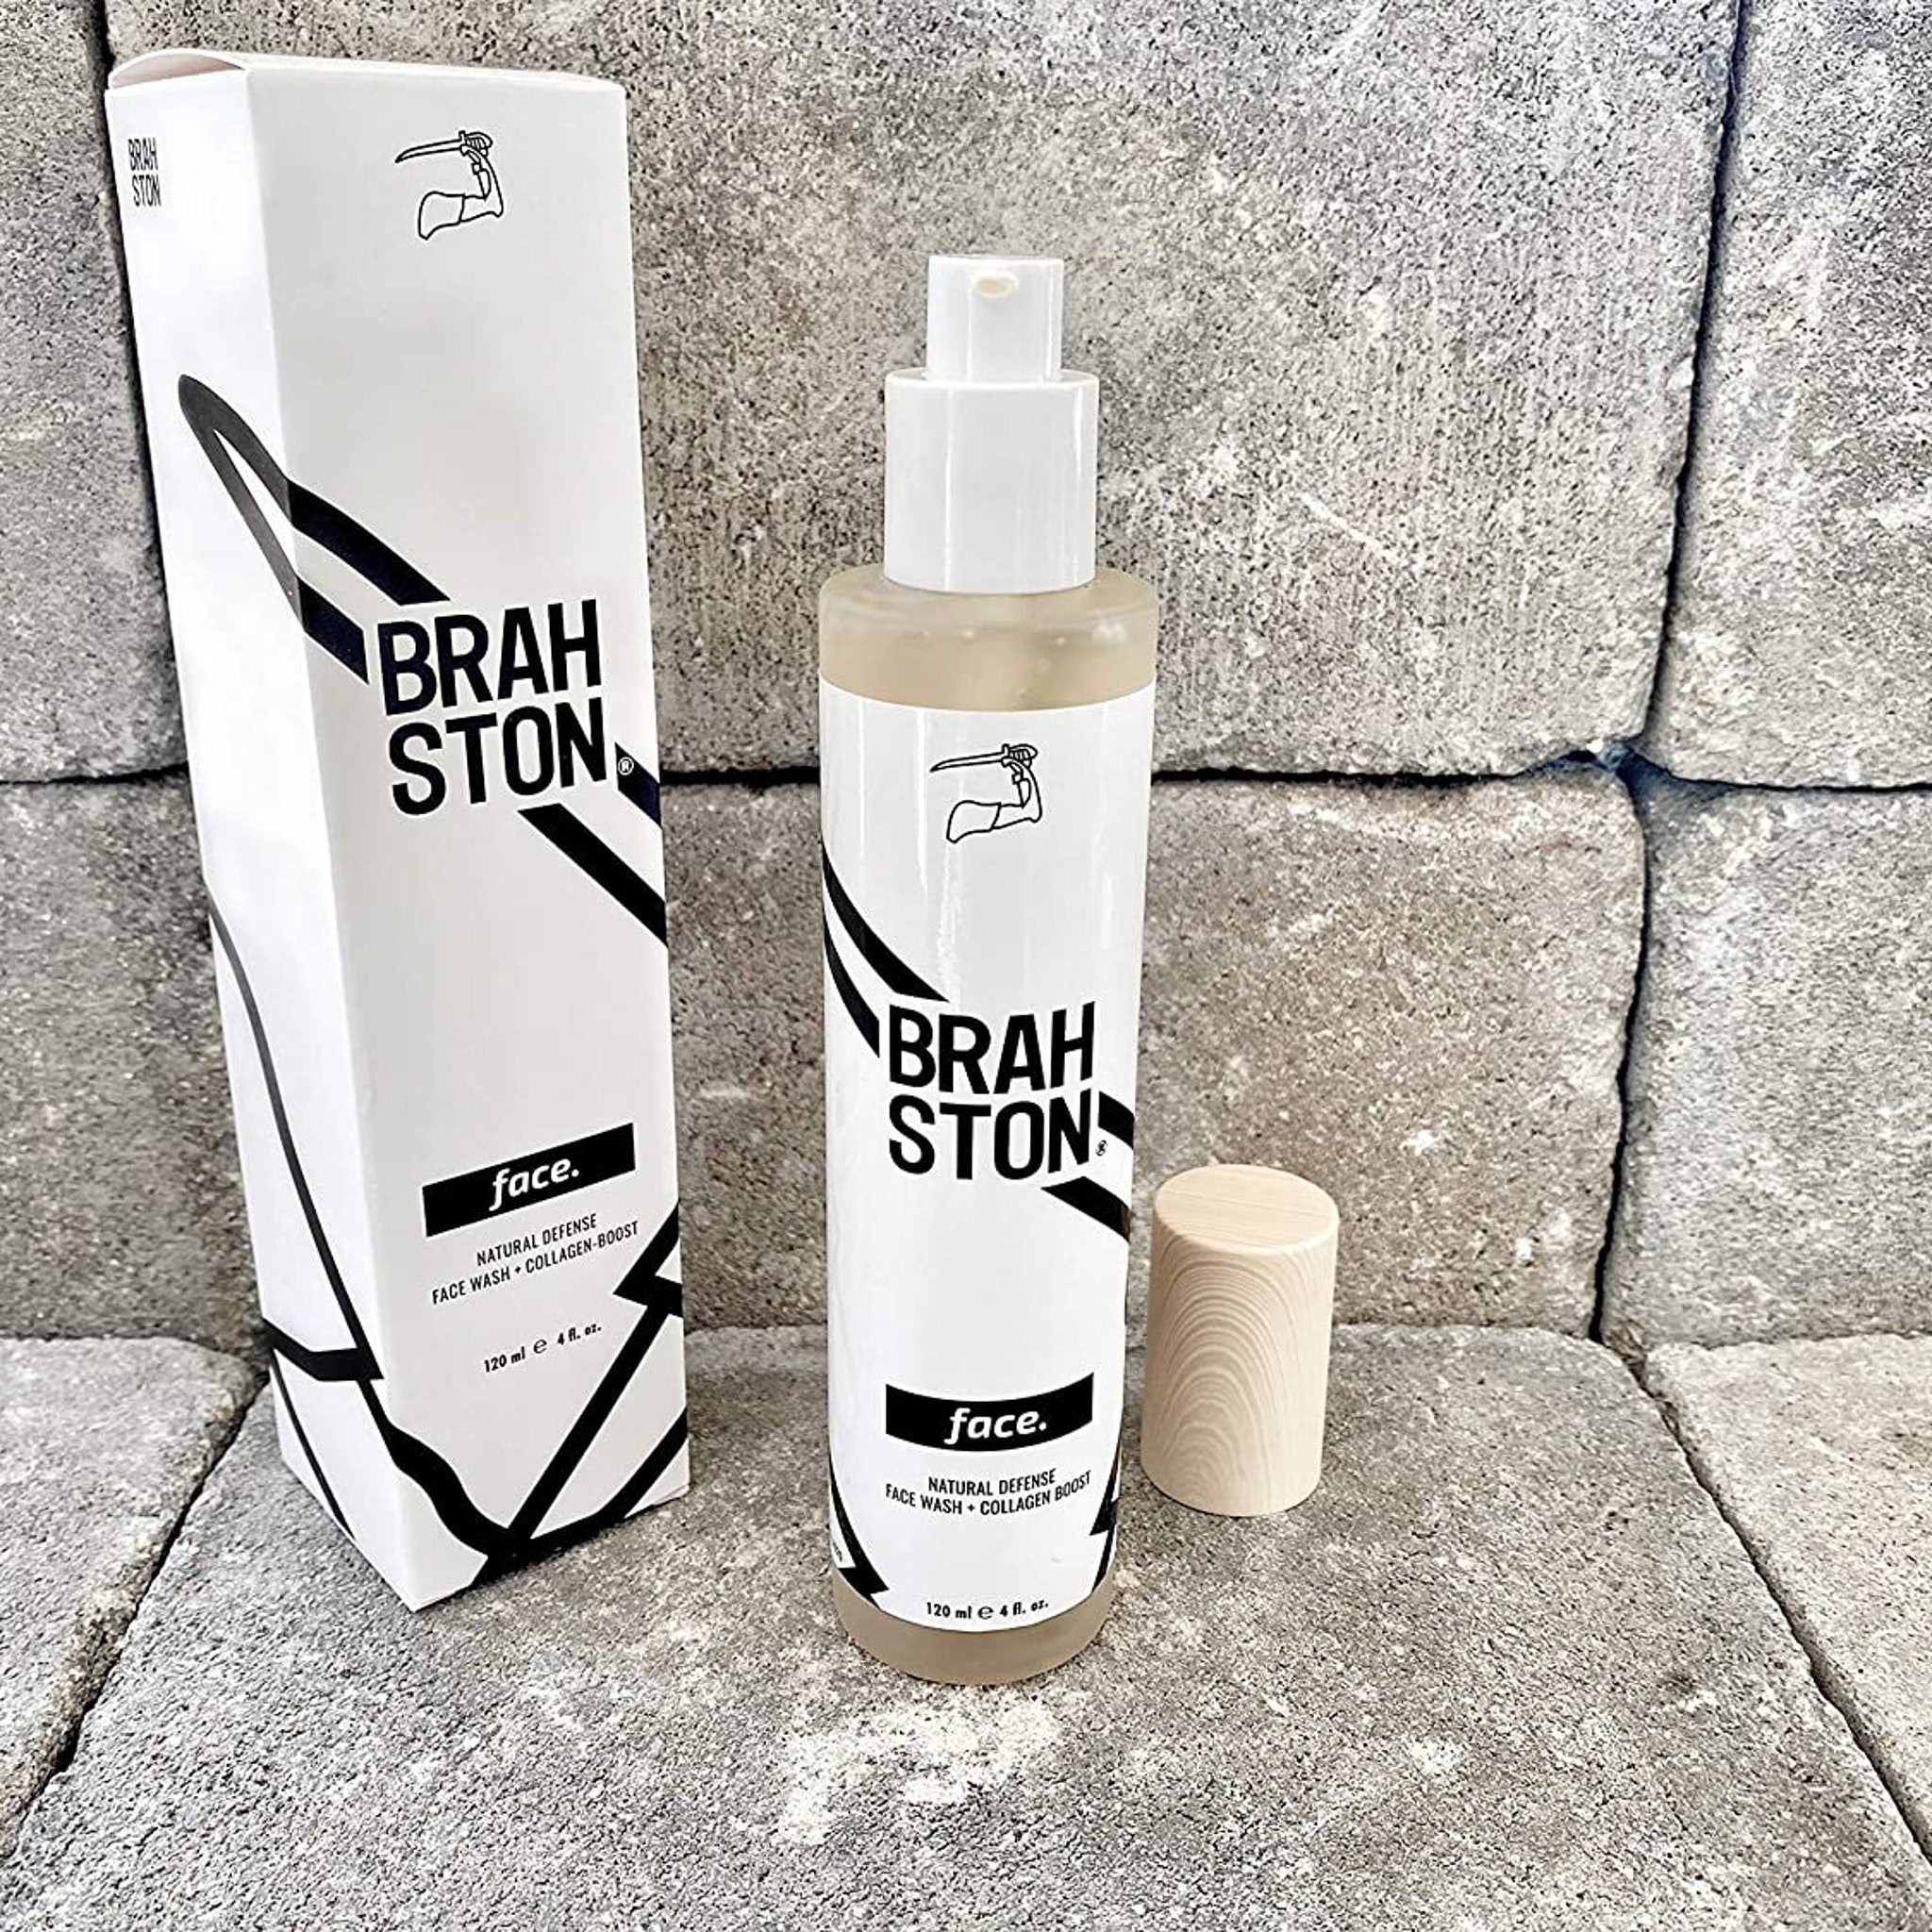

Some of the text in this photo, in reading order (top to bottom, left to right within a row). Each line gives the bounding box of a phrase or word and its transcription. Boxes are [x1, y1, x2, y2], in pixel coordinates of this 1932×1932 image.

[377, 599, 601, 715] BRAH
[389, 696, 608, 816] STON
[890, 1001, 1095, 1094] BRAH
[890, 1088, 1091, 1180] STON
[489, 1158, 580, 1211] face.
[432, 1280, 466, 1305] FACE
[471, 1266, 510, 1291] WASH
[525, 1221, 639, 1274] COLLAGEN-BOOST
[476, 1213, 597, 1266] NATURAL DEFENSE
[483, 1355, 508, 1373] 120
[510, 1346, 525, 1363] ml
[557, 1333, 565, 1346] 4
[568, 1327, 581, 1341] fl.
[585, 1323, 602, 1336] oz.
[943, 1407, 1048, 1445] face.
[886, 1483, 916, 1507] FACE
[921, 1494, 963, 1515] WASH
[980, 1490, 1052, 1516] COLLAGEN
[1055, 1470, 1091, 1502] BOOST
[928, 1468, 1057, 1496] NATURAL DEFENSE
[925, 1602, 951, 1617] 120
[955, 1606, 972, 1620] ml
[1000, 1605, 1008, 1617] 4
[1012, 1601, 1026, 1616] fl.
[1031, 1600, 1049, 1612] oz.
